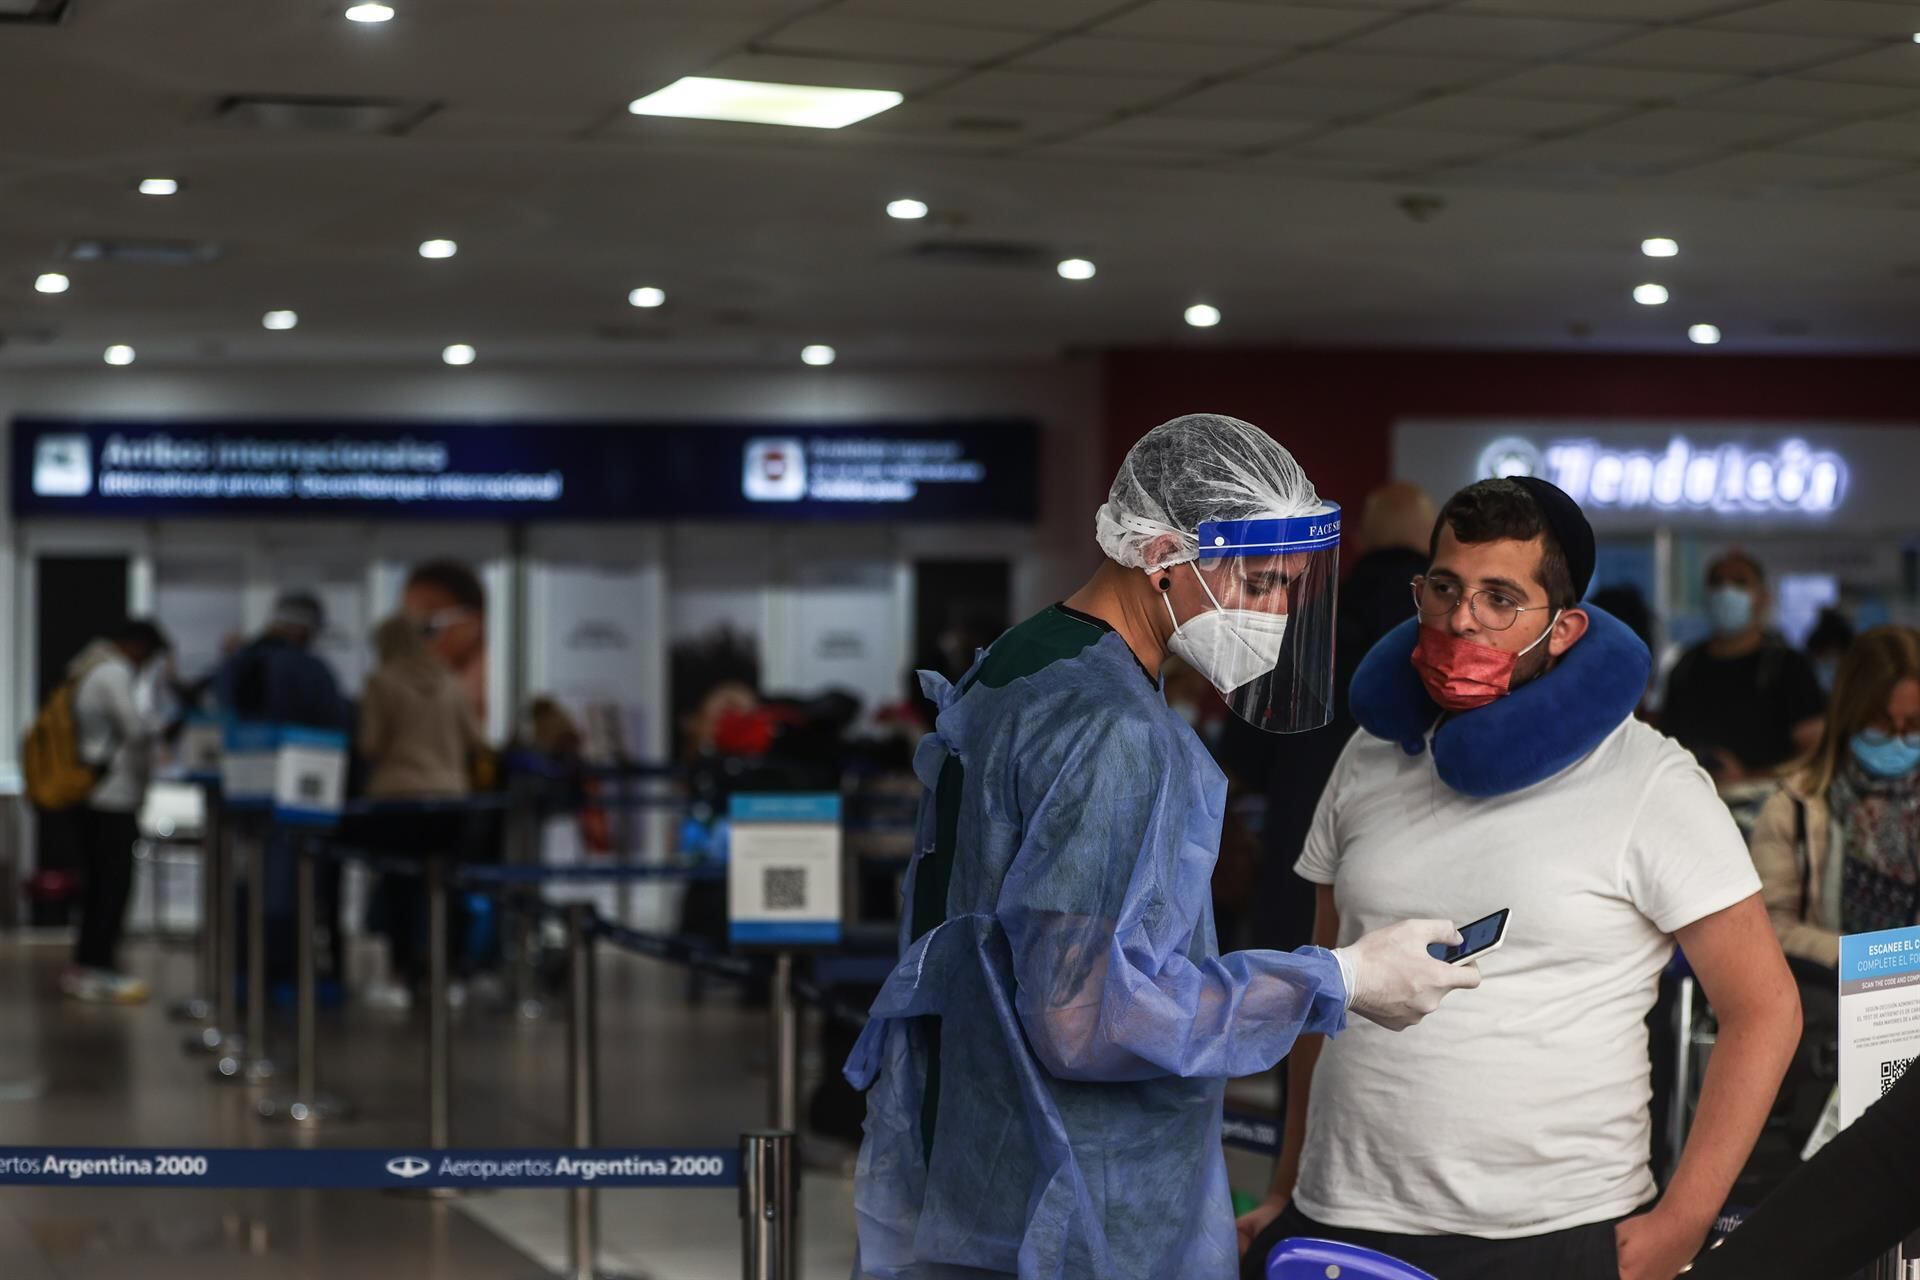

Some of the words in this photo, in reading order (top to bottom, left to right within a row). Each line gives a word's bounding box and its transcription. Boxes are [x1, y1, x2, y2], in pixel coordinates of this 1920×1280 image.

[1309, 523, 1332, 536] FACE
[1868, 941, 1903, 956] ESCANEE
[1904, 939, 1913, 951] EL
[1857, 955, 1897, 972] COMPLETE
[1898, 954, 1908, 966] EL
[1909, 952, 1920, 964] FO
[1862, 979, 1874, 989] SCAN
[1874, 978, 1883, 988] THE
[1883, 976, 1896, 987] CODE
[1897, 975, 1906, 985] AND
[1907, 973, 1920, 983] COMP
[43, 1155, 152, 1179] Argentina
[155, 1156, 208, 1176] 2000
[438, 1157, 553, 1179] Aeropuertos
[555, 1156, 666, 1179] Argentina
[669, 1157, 723, 1176] 2000
